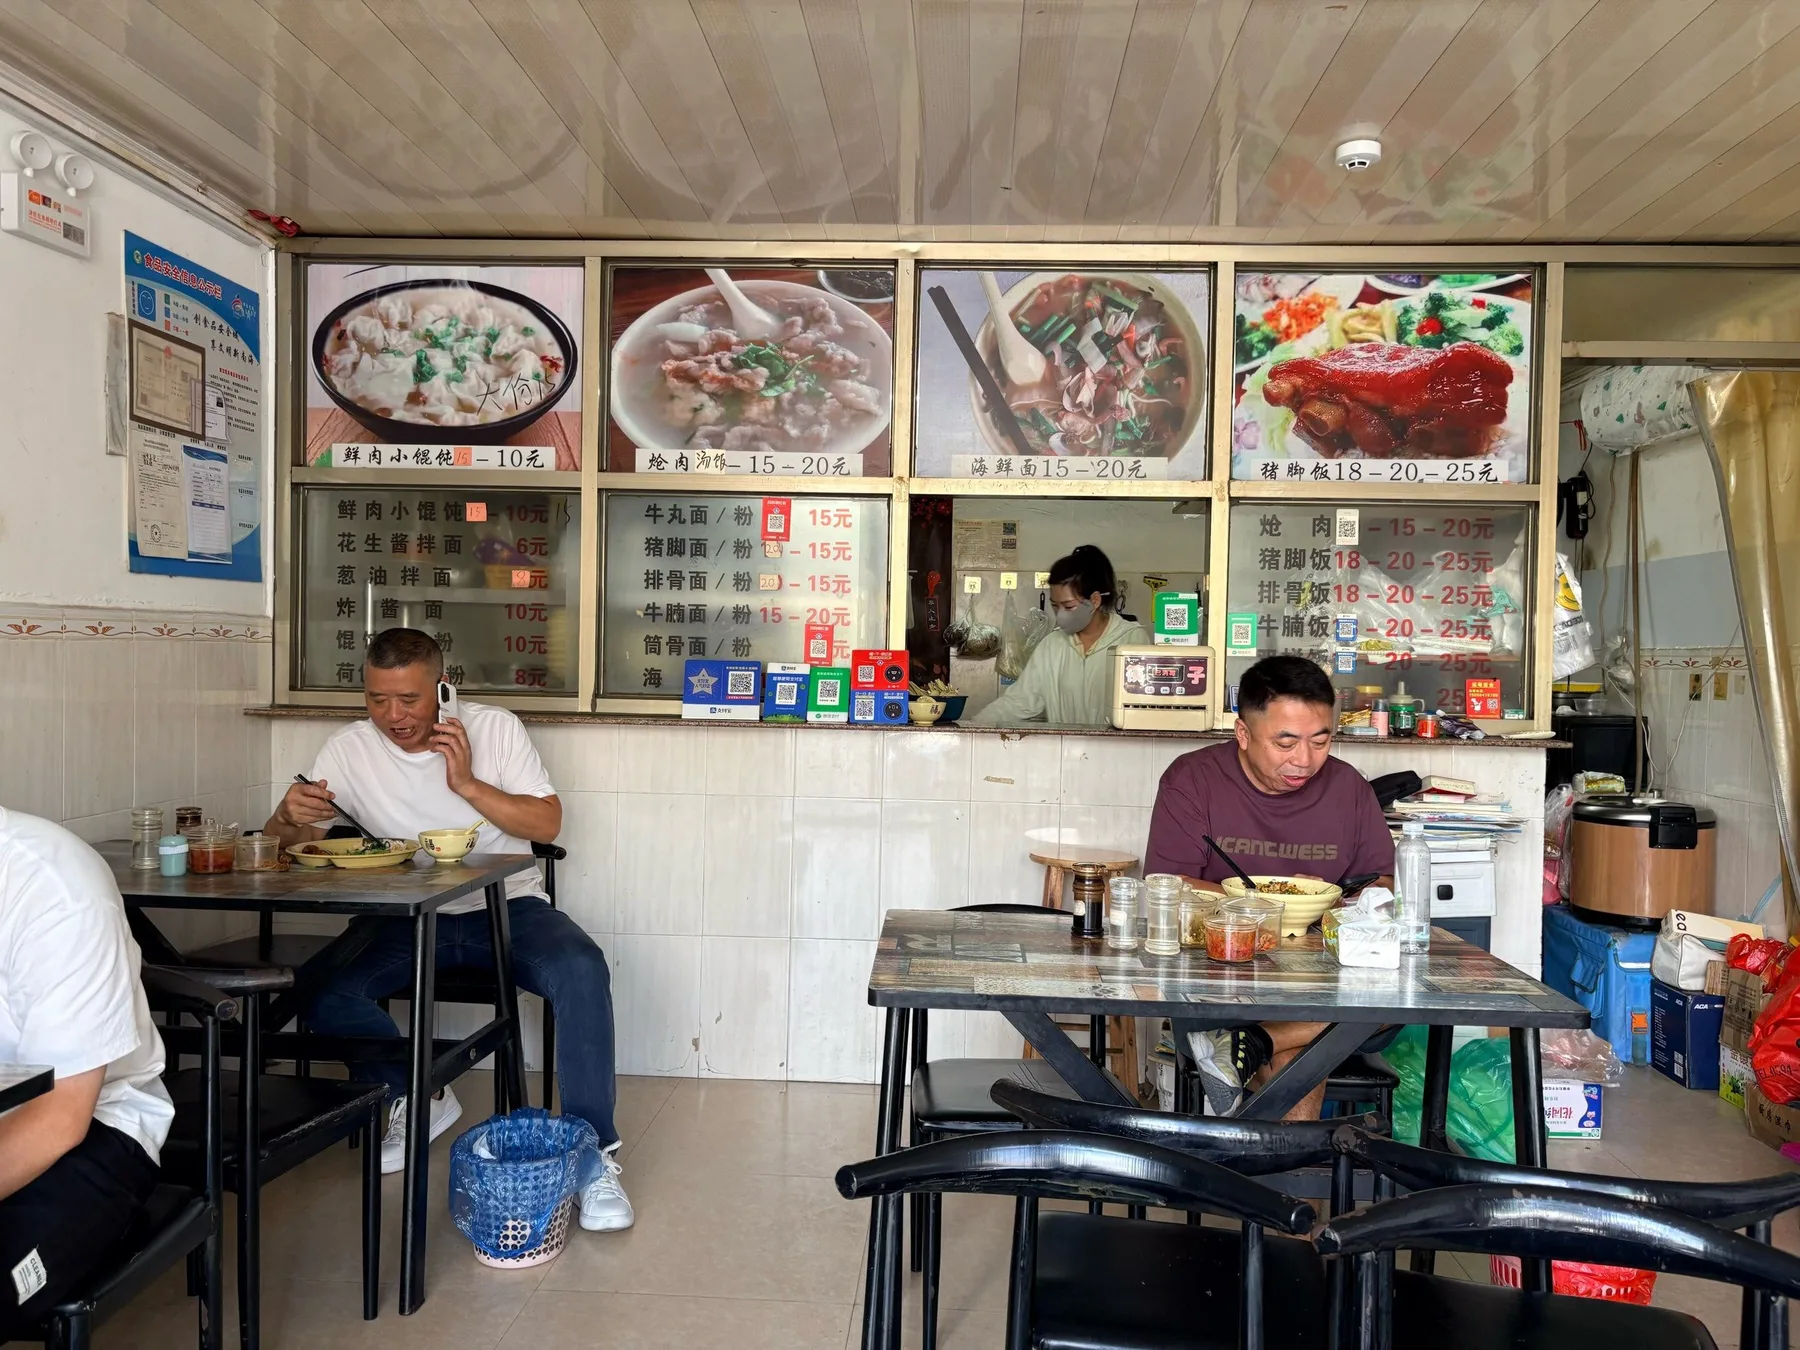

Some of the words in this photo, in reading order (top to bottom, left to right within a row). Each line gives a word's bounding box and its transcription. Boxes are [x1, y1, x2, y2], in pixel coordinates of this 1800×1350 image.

[144, 253, 222, 300] 食品安全信息公示栏
[343, 446, 454, 466] 鲜肉小馄饨
[337, 500, 464, 522] 鲜肉小馄饨
[808, 508, 853, 529] 15元
[337, 532, 463, 555] 花生酱拌面
[517, 537, 549, 557] 6元
[1258, 548, 1331, 571] 猪脚饭
[337, 565, 451, 587] 葱油拌面
[1258, 580, 1331, 604] 排骨饭
[336, 598, 443, 620] 炸酱面
[504, 603, 548, 622] 10元
[504, 636, 548, 655] 10元
[515, 668, 548, 687] 8元
